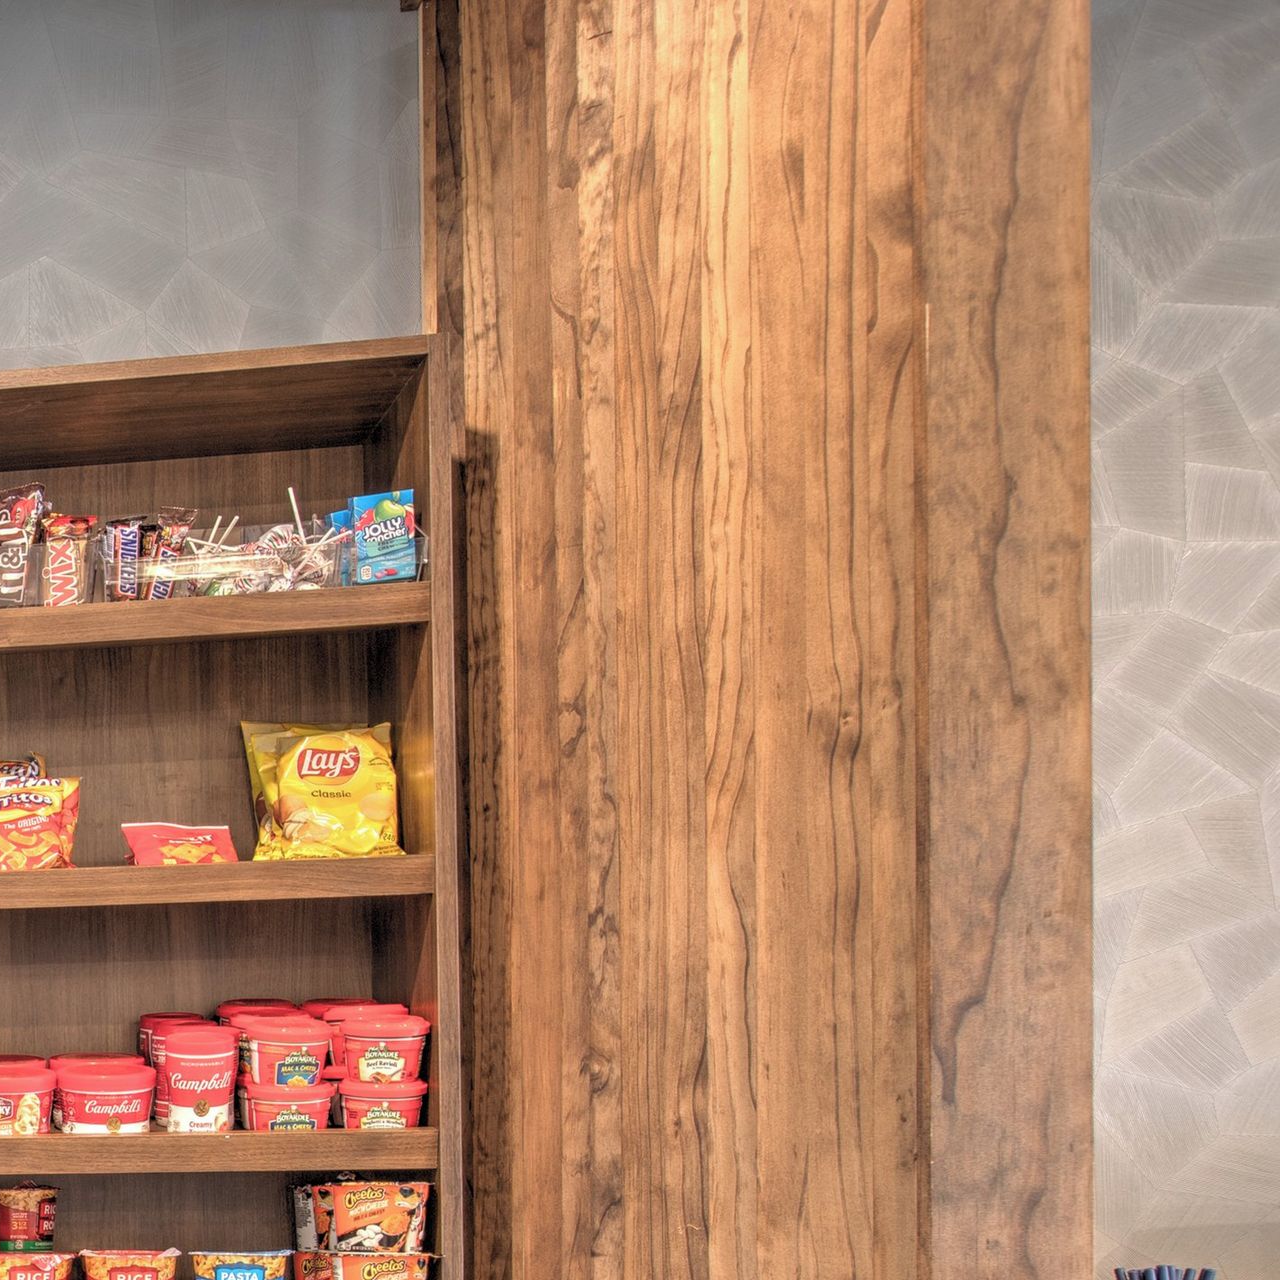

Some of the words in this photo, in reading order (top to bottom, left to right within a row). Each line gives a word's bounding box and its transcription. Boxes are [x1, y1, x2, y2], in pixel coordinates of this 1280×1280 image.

[363, 515, 403, 540] JOLLY
[119, 527, 138, 597] SNICKERS
[299, 746, 361, 778] Lay's
[310, 789, 352, 799] Classic
[284, 1054, 318, 1065] BOYARDEE
[364, 1050, 400, 1060] BOYARDEE
[365, 1059, 378, 1068] Beef
[377, 1060, 399, 1069] Ravioli
[170, 1070, 232, 1092] Campbell's
[84, 1098, 141, 1115] Campbell's
[276, 1114, 311, 1124] BOYARDEE
[366, 1110, 401, 1120] BOYARDEE
[189, 1120, 214, 1130] Creamy
[344, 1187, 386, 1209] Cheetos
[361, 1258, 407, 1280] Cheetos
